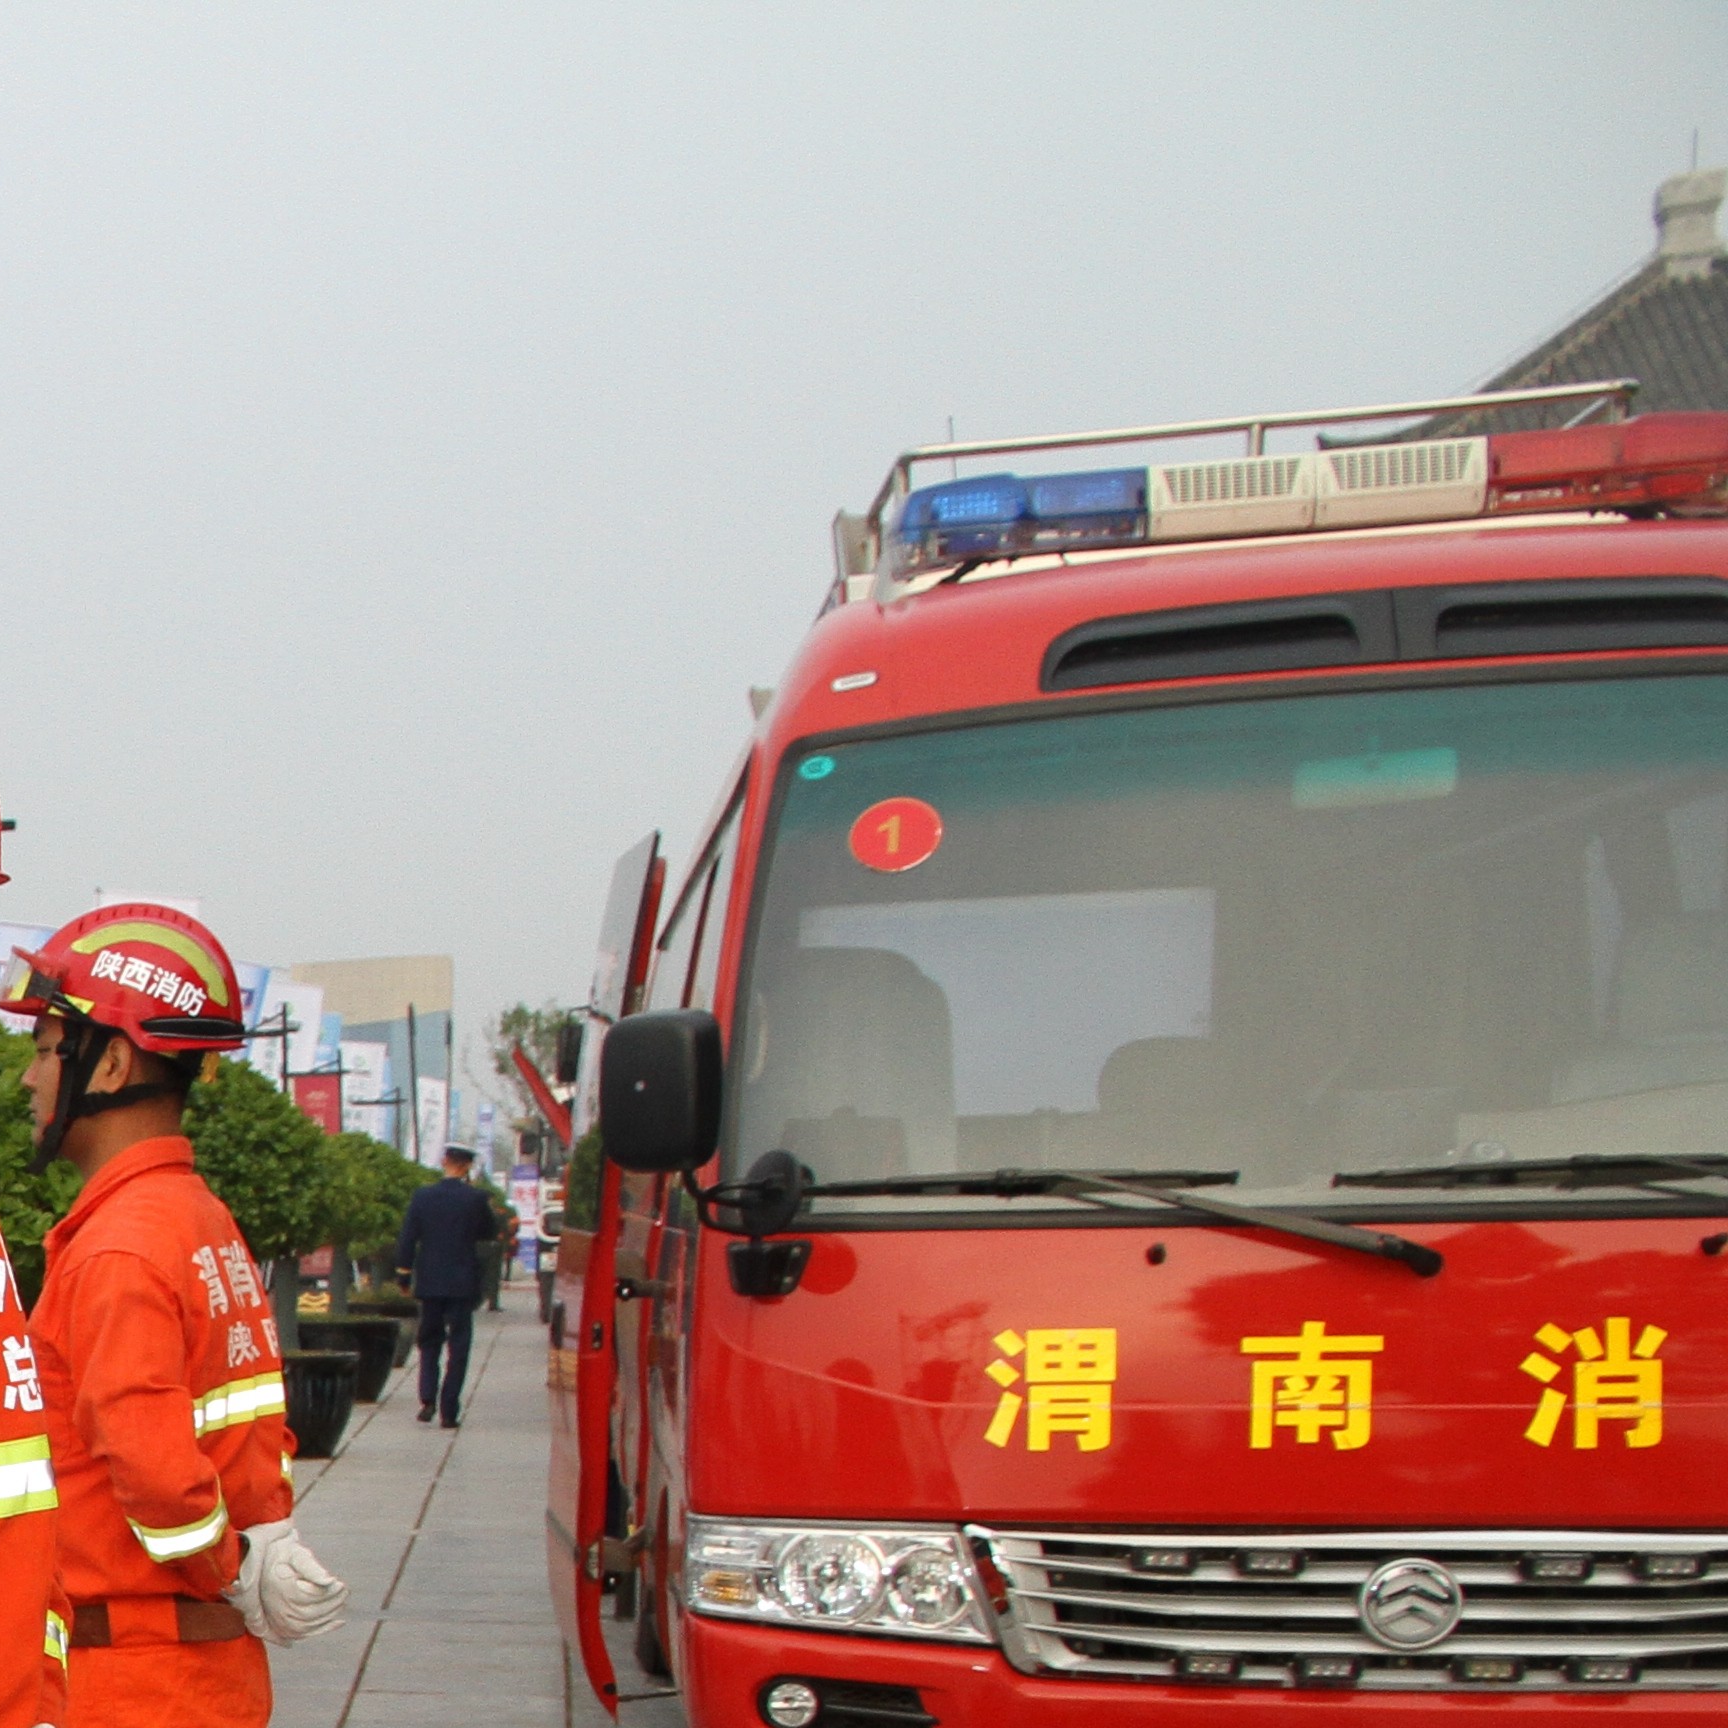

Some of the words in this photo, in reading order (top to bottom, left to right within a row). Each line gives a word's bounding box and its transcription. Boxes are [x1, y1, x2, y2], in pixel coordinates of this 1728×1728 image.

[877, 815, 902, 854] 1
[91, 949, 206, 1017] 陕西消防
